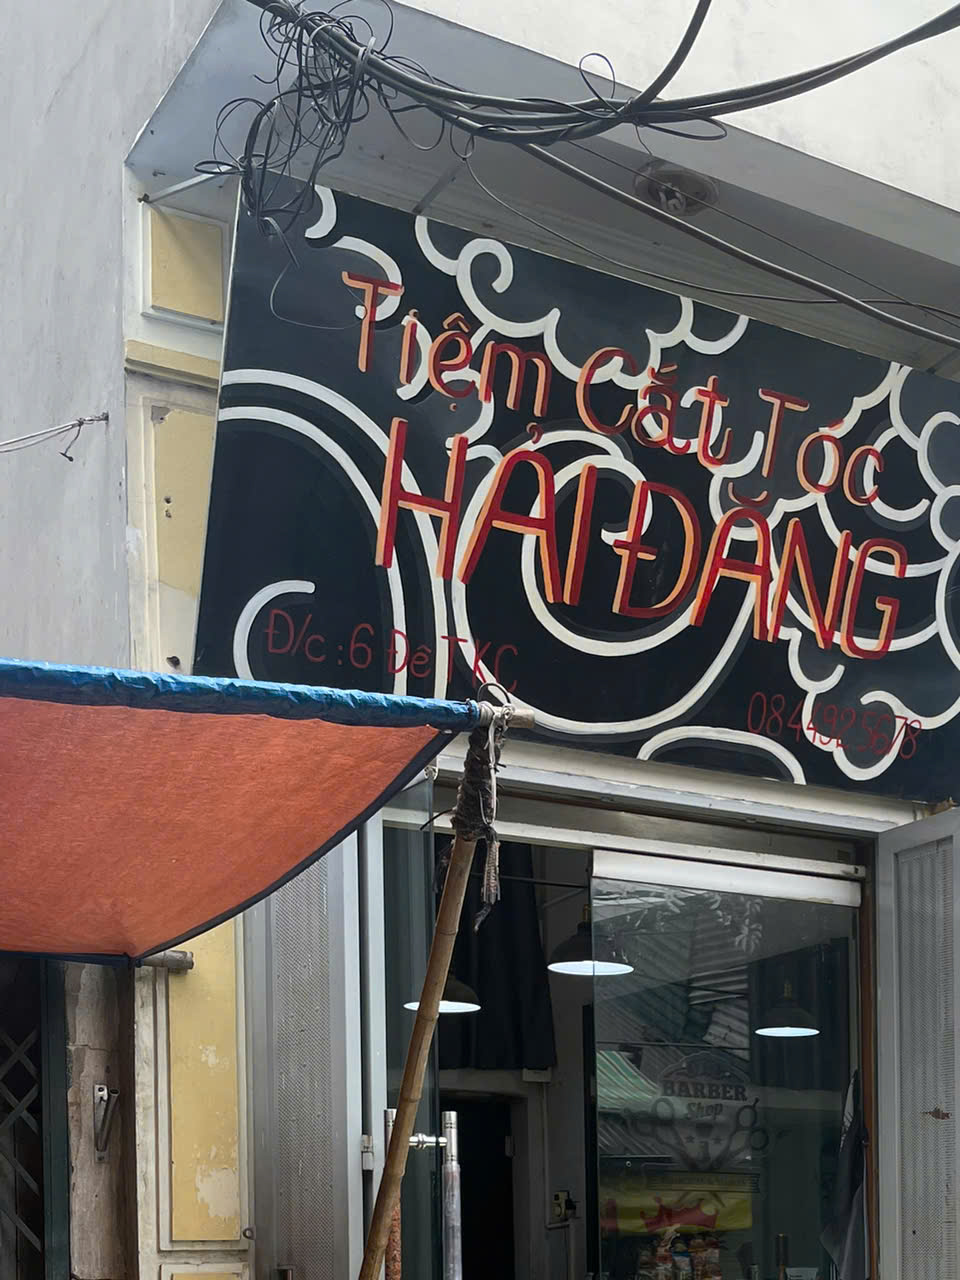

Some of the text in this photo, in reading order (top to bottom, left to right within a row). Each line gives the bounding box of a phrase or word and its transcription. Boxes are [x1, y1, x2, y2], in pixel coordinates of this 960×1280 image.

[341, 271, 884, 506] Tiệm Cắt Tóc
[611, 481, 908, 660] ĐĂNG
[662, 1080, 747, 1101] BARBER
